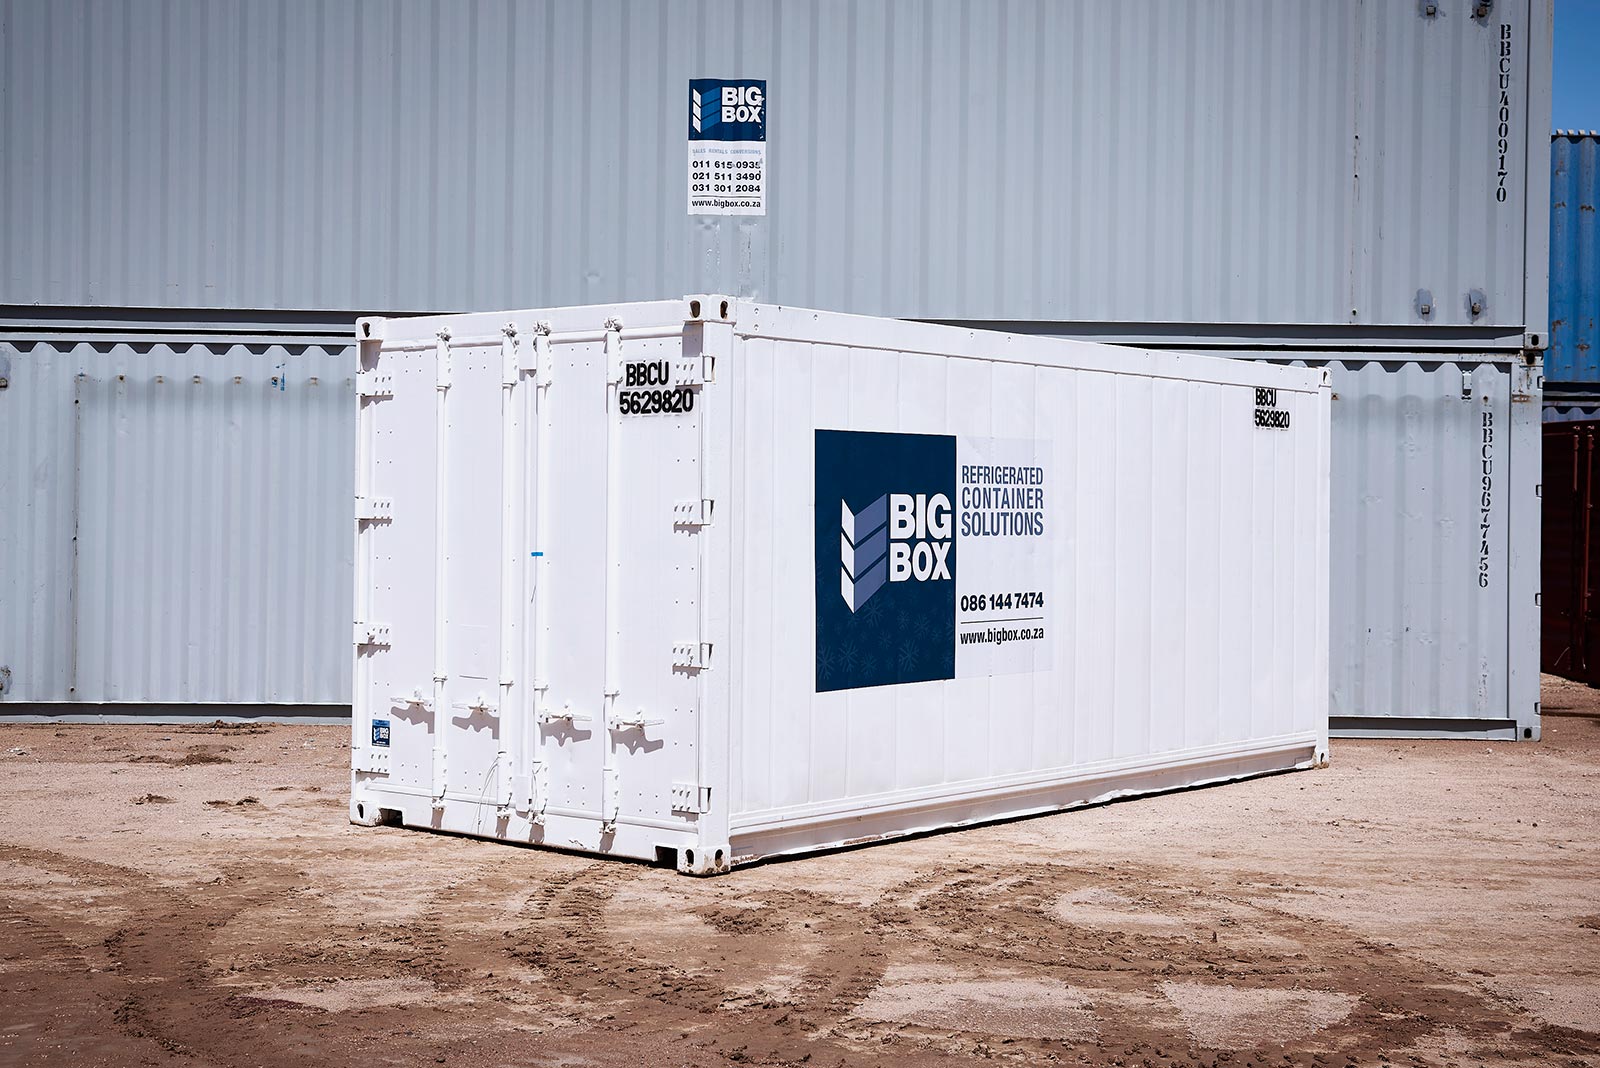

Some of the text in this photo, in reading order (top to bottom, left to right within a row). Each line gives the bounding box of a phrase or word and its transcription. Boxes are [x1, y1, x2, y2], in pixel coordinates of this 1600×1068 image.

[722, 86, 762, 106] BIG
[722, 106, 761, 123] BOX
[1496, 24, 1511, 202] BBCU4009170
[692, 160, 761, 169] 011 615 0935
[692, 172, 710, 180] 021
[736, 173, 761, 181] 3490
[692, 184, 710, 192] 031
[714, 184, 732, 192] 301
[692, 200, 761, 209] www.bigbox.co.za
[626, 361, 669, 386] BBCU
[619, 389, 694, 414] 5629820
[1256, 388, 1276, 407] BBCU
[1255, 409, 1290, 428] 5629820
[961, 465, 1043, 485] REFRIGERATED
[961, 487, 1044, 509] CONTAINER
[1479, 412, 1493, 588] BBCU9677456
[890, 493, 952, 540] BIG
[961, 511, 1044, 536] SOLUTIONS
[889, 541, 952, 582] BOX
[960, 592, 1044, 612] 086 144 7474
[960, 627, 1044, 645] www.bigbox.co.za
